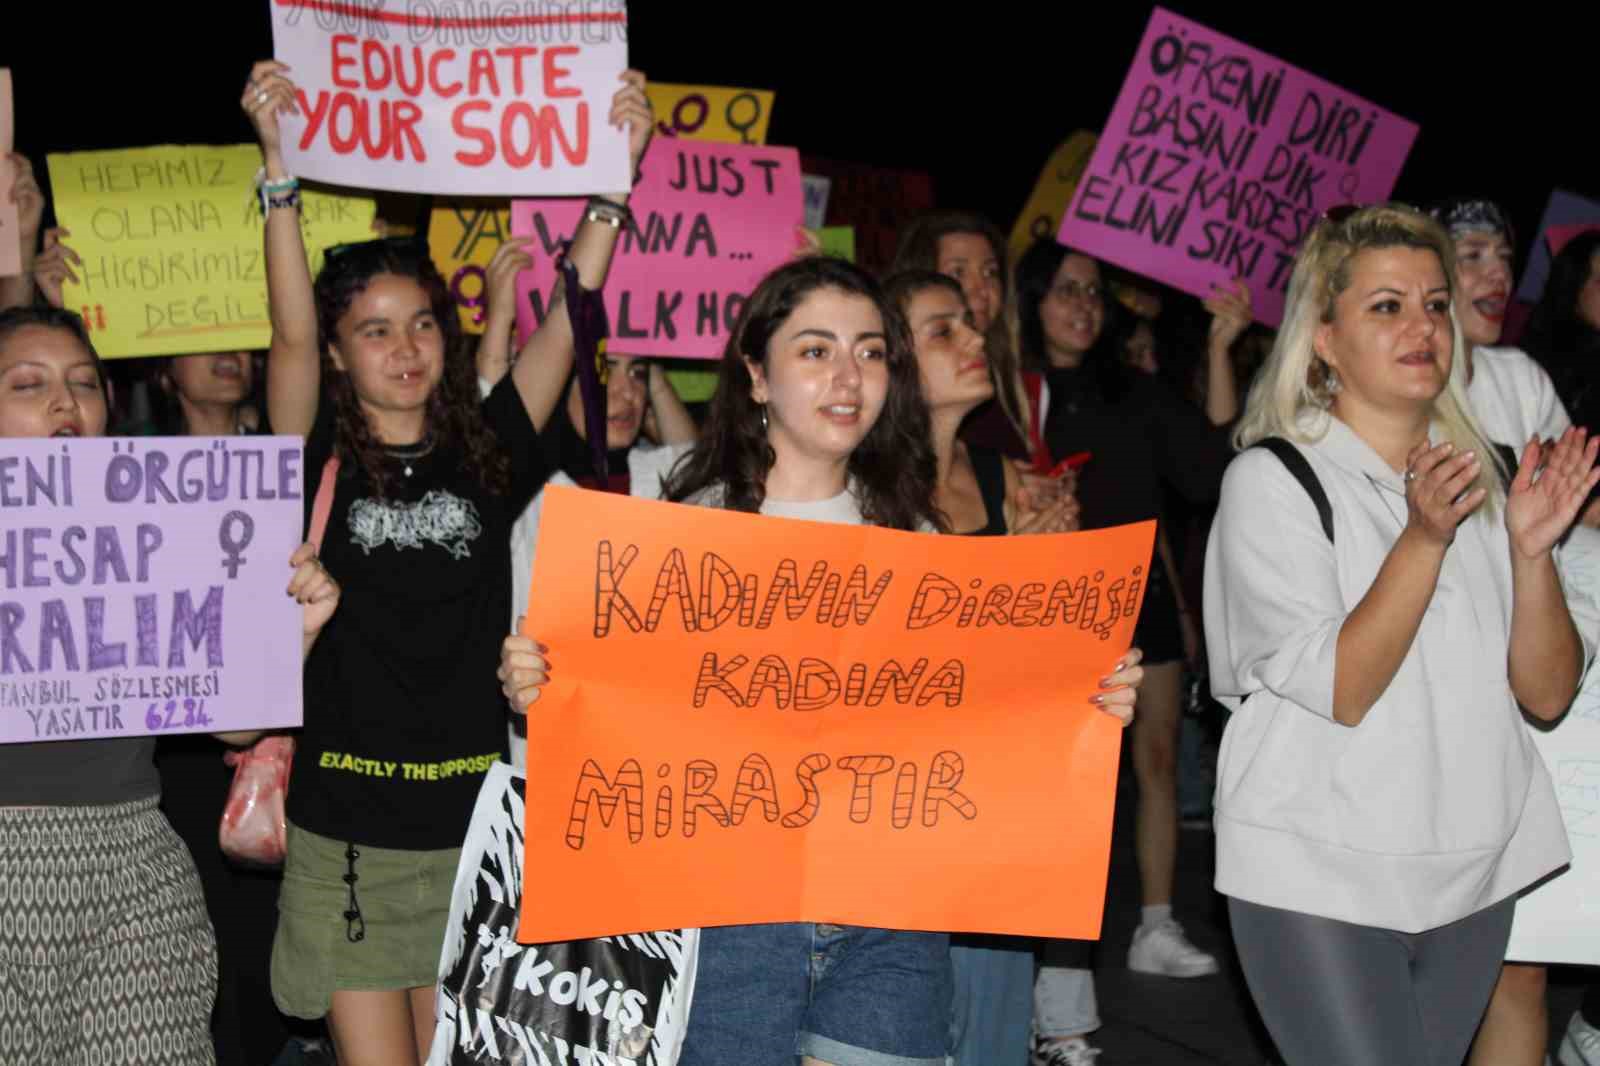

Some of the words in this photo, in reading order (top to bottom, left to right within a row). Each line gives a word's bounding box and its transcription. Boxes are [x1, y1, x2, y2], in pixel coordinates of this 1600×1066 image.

[331, 34, 583, 98] EDUCATE
[296, 89, 427, 163] YOUR
[451, 101, 589, 169] SON
[668, 151, 781, 197] JUST
[91, 199, 222, 243] OLANA
[1266, 252, 1295, 296] T
[696, 291, 746, 336] HO
[104, 440, 301, 504] ÖRGÜTLE
[0, 523, 163, 589] HESAP
[594, 540, 893, 638] KADININ
[0, 585, 224, 675] RALIM
[694, 652, 965, 711] KADINA
[145, 698, 213, 730] 6284
[319, 751, 397, 778] EXACTLY
[402, 763, 438, 781] THE
[439, 752, 501, 778] OPPOSI
